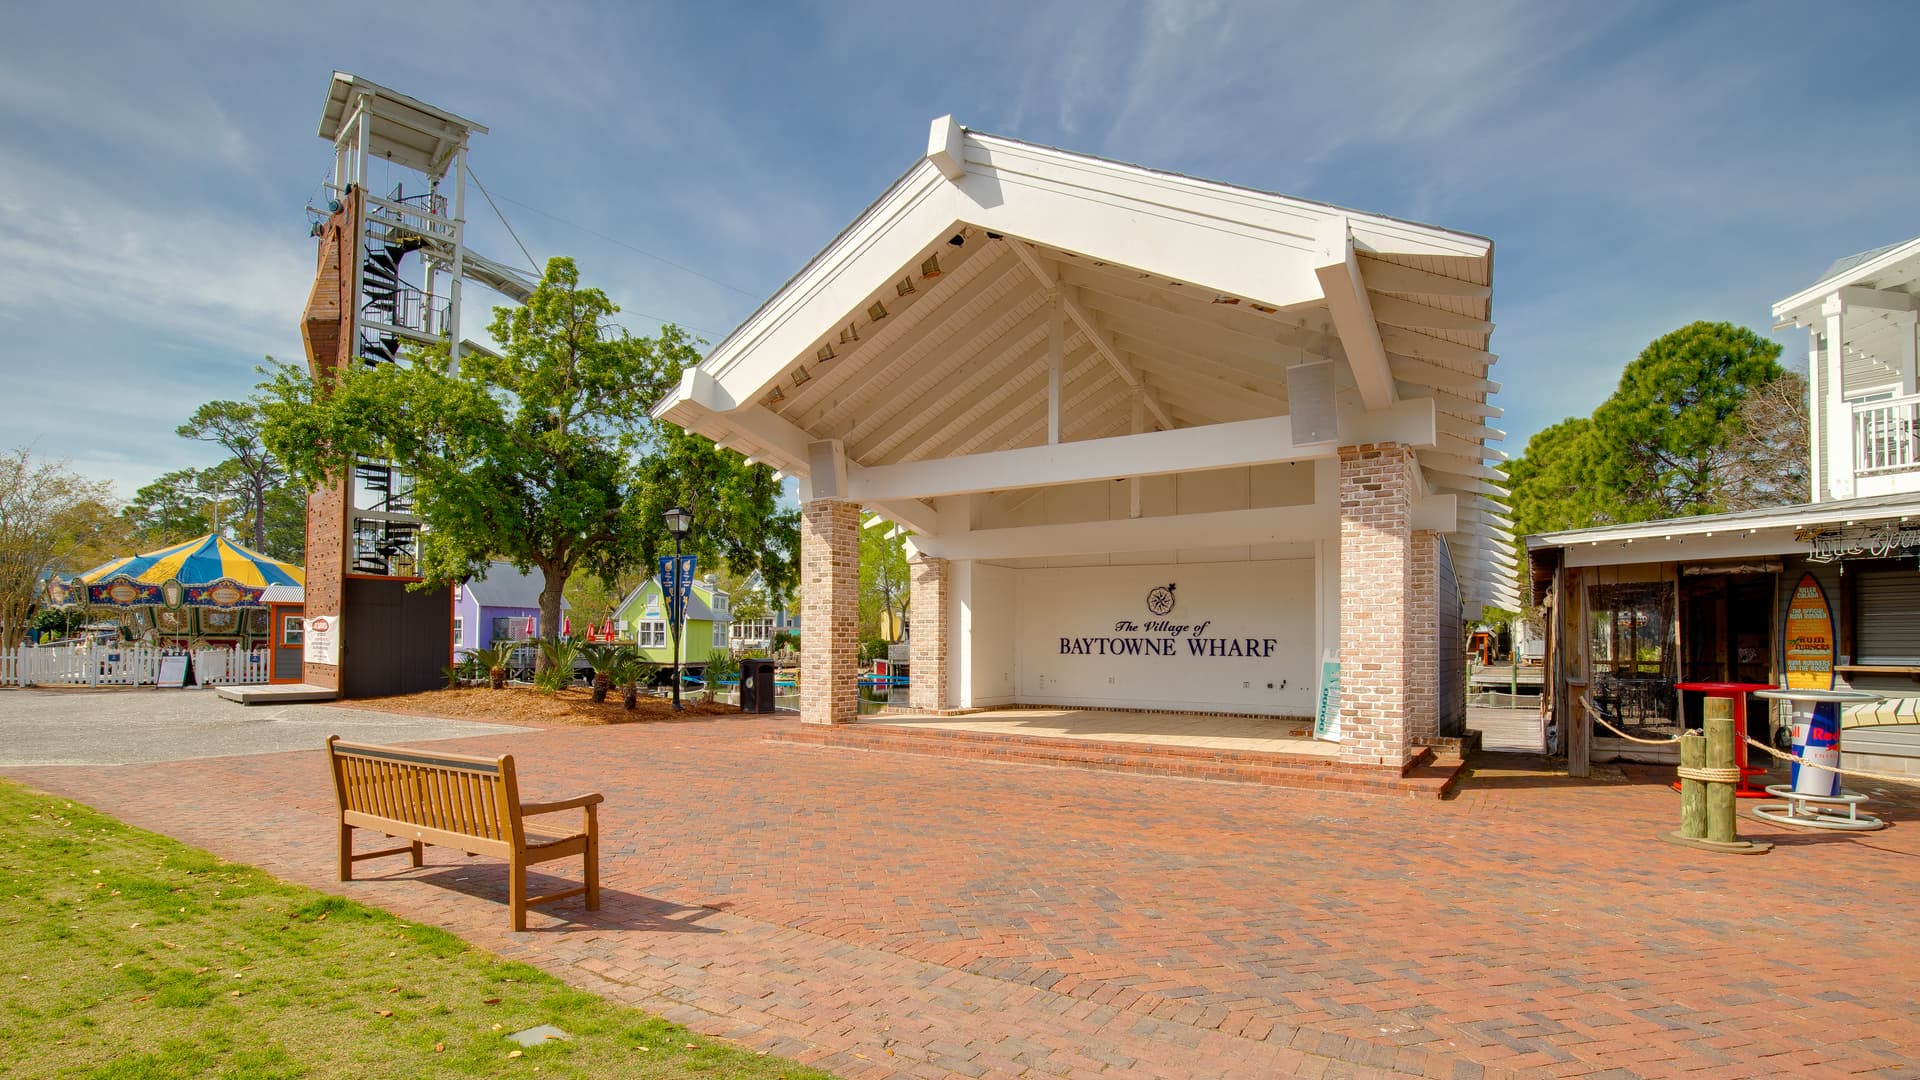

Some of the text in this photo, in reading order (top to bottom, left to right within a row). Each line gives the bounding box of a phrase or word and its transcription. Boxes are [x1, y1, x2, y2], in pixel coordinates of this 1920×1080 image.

[1114, 621, 1211, 637] The Village of
[1059, 637, 1278, 657] BAYTOWNE WHARF
